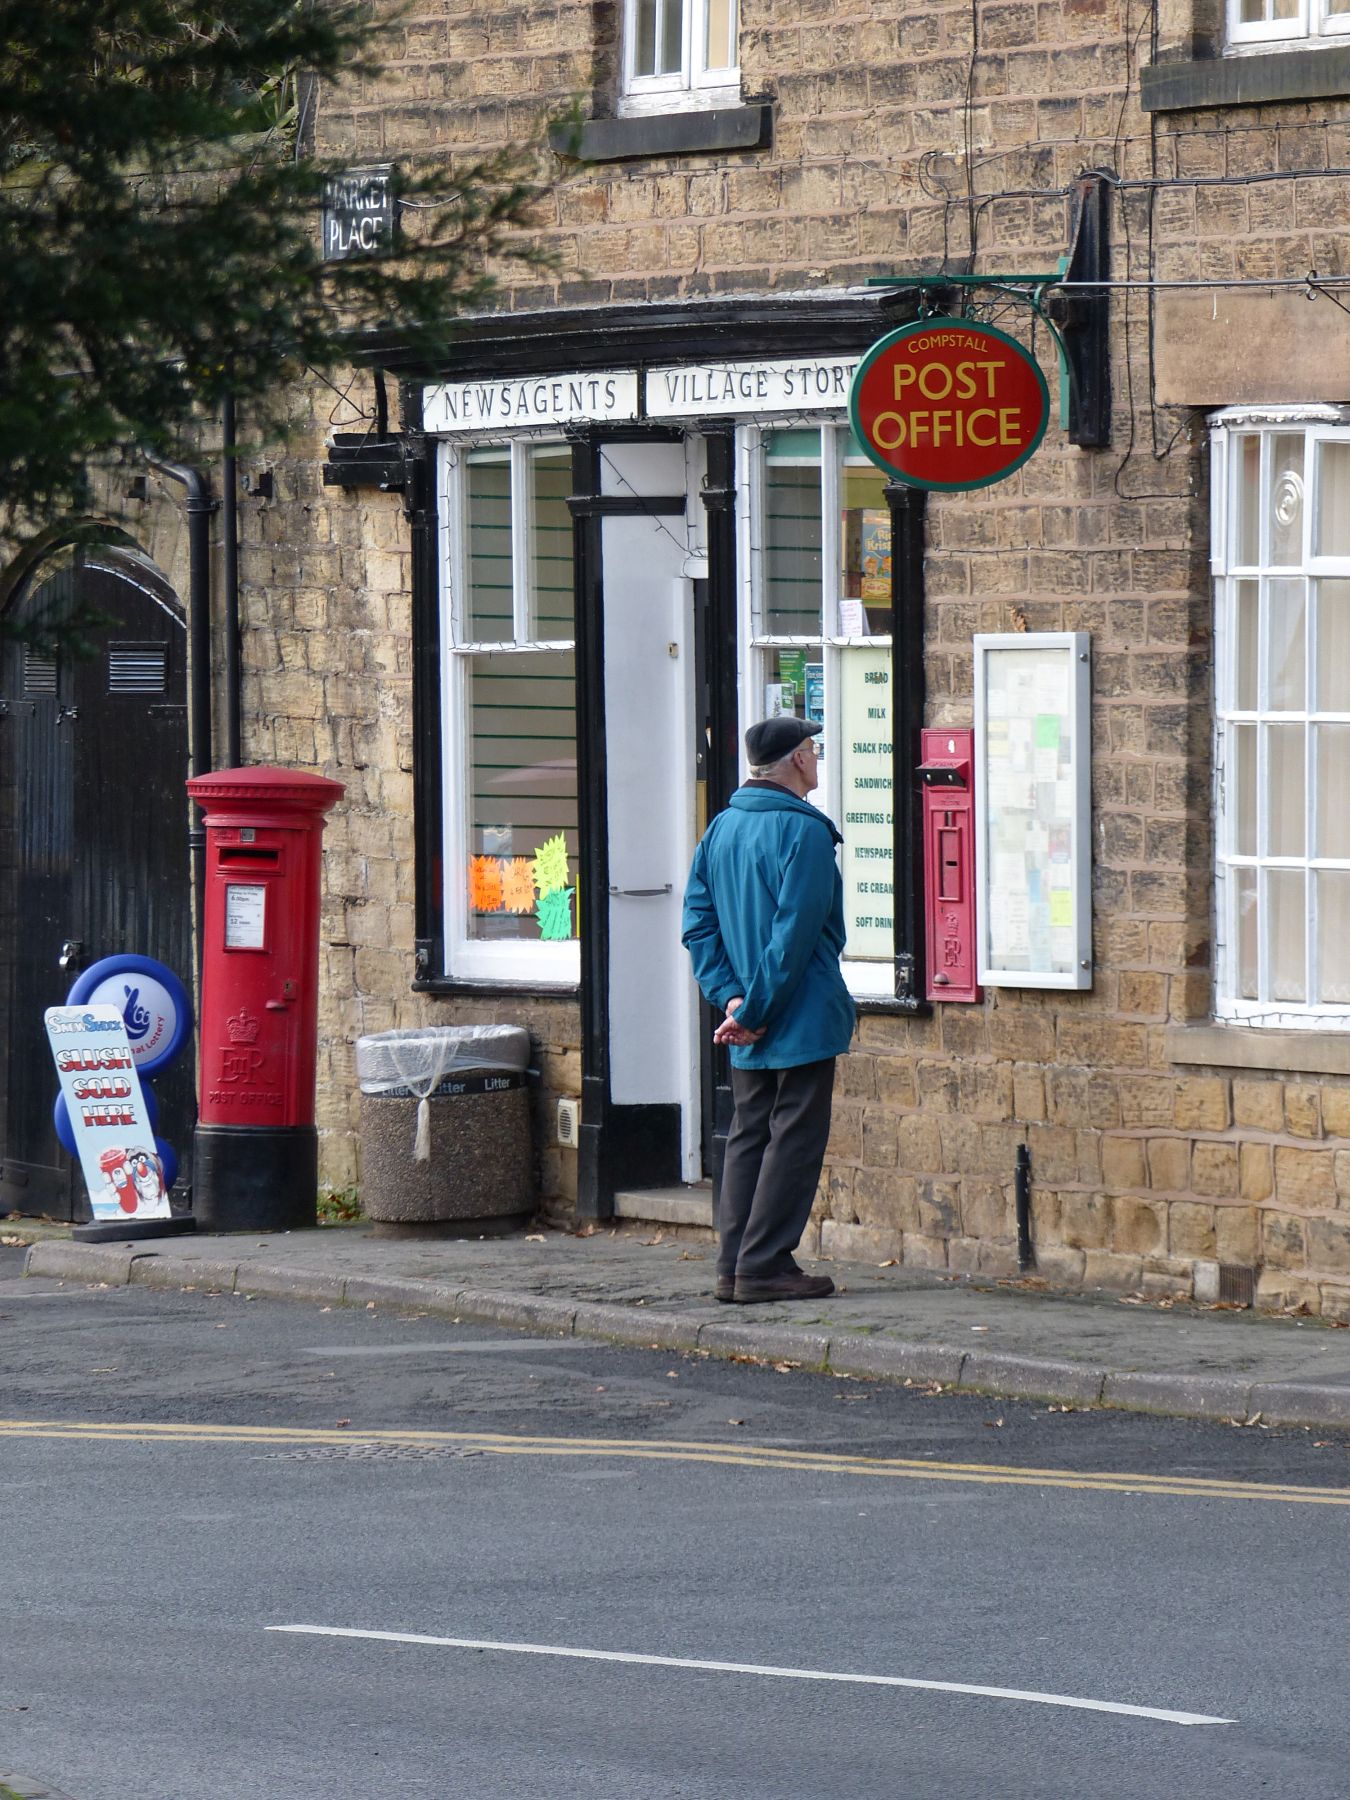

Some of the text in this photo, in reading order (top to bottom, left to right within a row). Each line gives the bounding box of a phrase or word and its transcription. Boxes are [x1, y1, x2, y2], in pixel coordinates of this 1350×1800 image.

[330, 216, 384, 251] PLACE
[907, 335, 988, 353] COMPSTALL
[666, 370, 768, 403] VILLAGE
[893, 361, 1006, 401] POST
[445, 379, 617, 420] NEWSAGENTS
[872, 407, 1022, 450] OFFICE
[868, 707, 886, 719] MILK
[852, 742, 877, 754] SNACK
[845, 812, 885, 824] GREETINGS
[857, 881, 869, 893] ICE
[855, 916, 873, 928] SOFT
[145, 1016, 165, 1049] Lottery
[56, 1047, 132, 1072] SLUSH
[72, 1076, 132, 1100] SOLD
[484, 1077, 510, 1091] Litter
[209, 1090, 283, 1105] POST OFFICE
[81, 1103, 138, 1127] HERE
